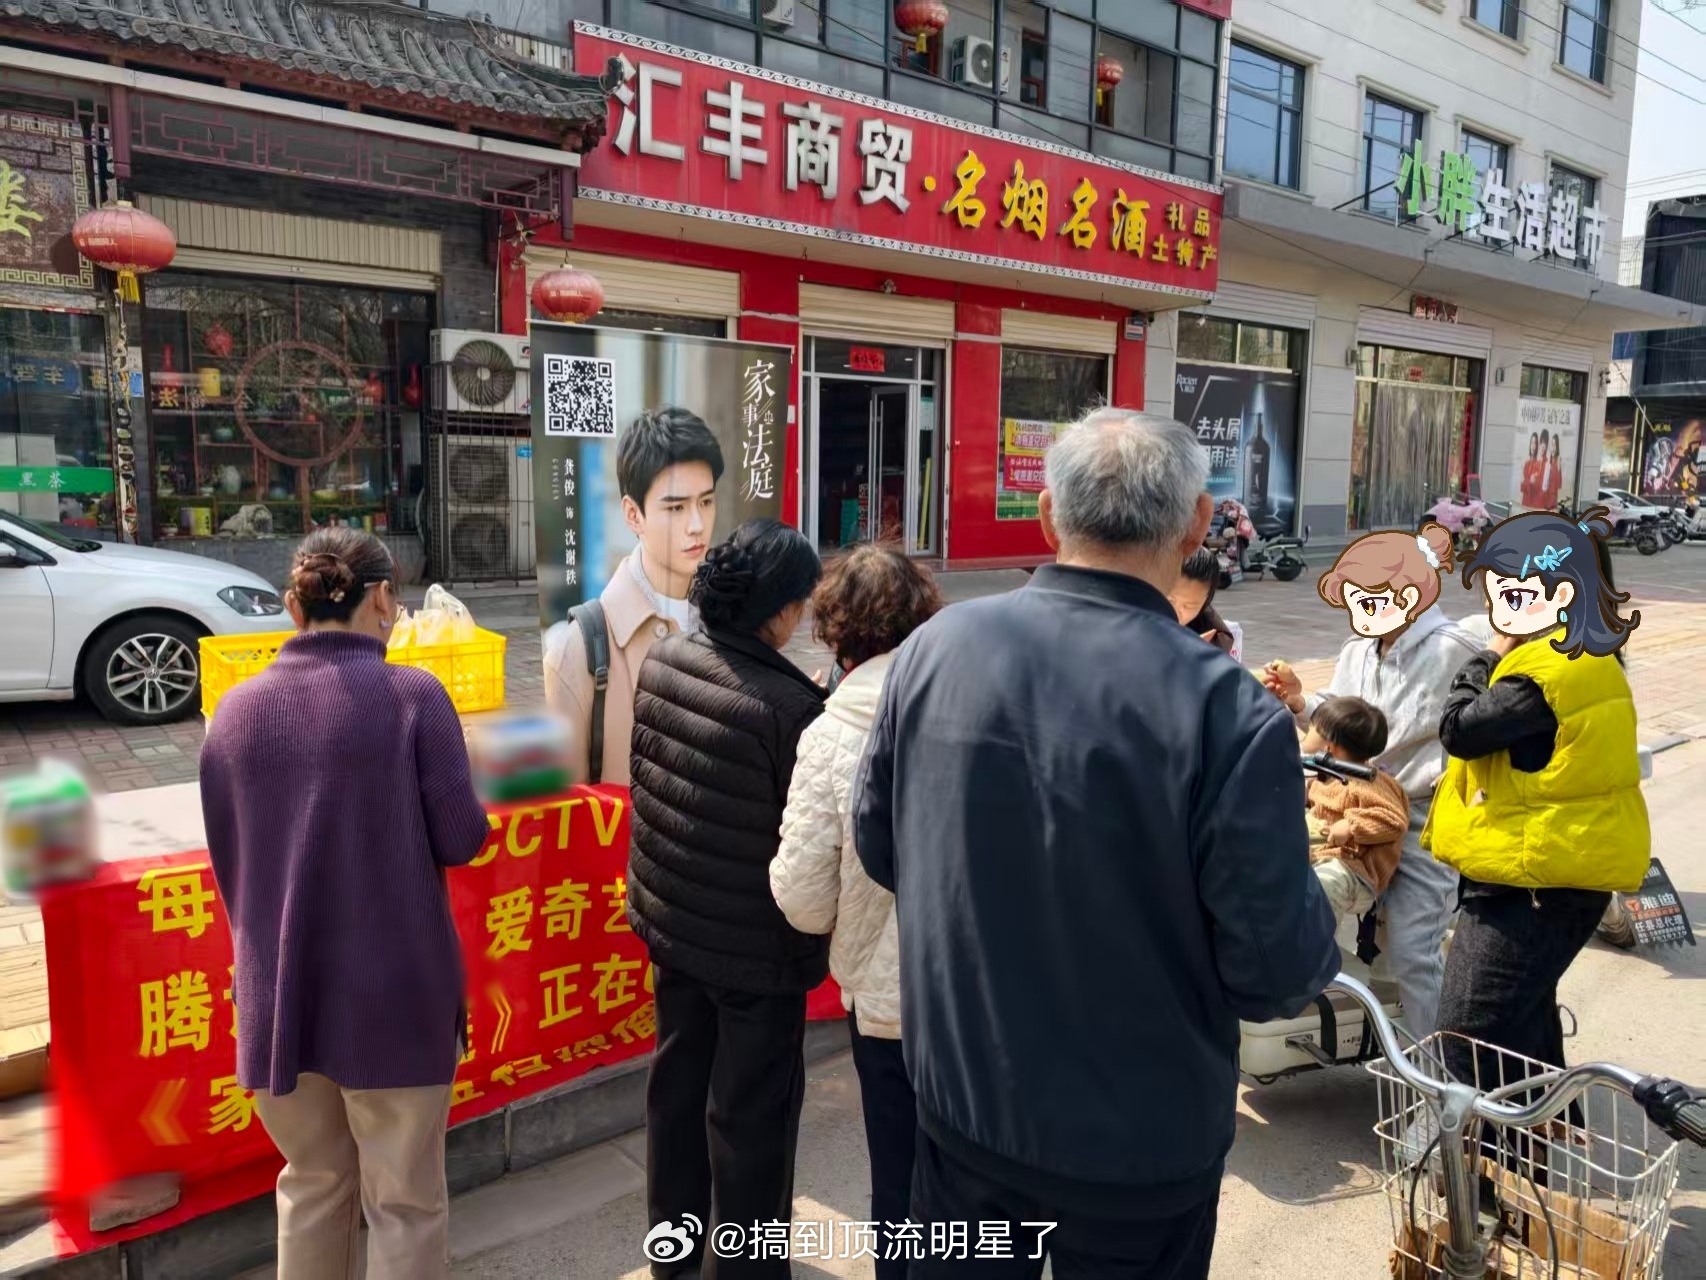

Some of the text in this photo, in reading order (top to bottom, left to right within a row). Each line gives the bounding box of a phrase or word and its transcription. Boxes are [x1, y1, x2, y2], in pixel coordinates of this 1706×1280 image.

[1165, 201, 1210, 238] 礼品
[1394, 138, 1608, 266] 小胖生活超市
[1150, 233, 1217, 270] 土特产
[741, 359, 776, 501] 家事法庭
[1196, 416, 1241, 440] 去头屑
[136, 862, 216, 939] 每
[1640, 893, 1677, 910] 雅迪
[139, 970, 238, 1058] 腾
